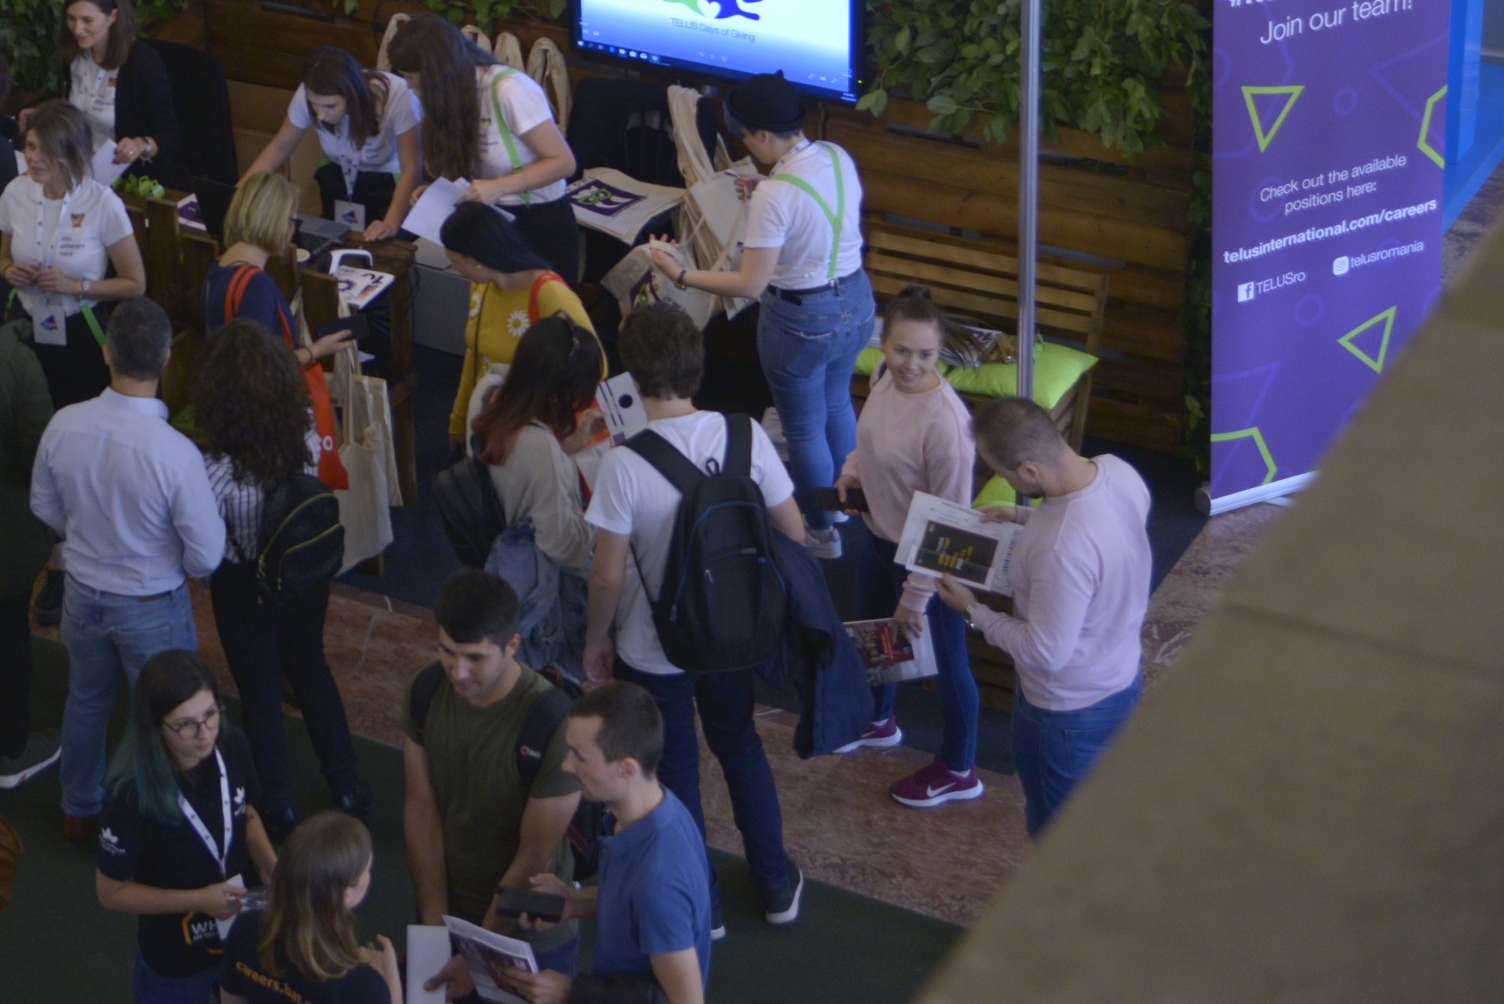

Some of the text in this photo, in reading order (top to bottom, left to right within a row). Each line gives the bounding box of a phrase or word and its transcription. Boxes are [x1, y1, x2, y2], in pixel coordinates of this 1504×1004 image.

[671, 17, 698, 30] TELUS
[699, 23, 719, 35] Days
[1260, 16, 1303, 44] Join
[1309, 7, 1347, 31] our
[1259, 154, 1408, 202] Check out the available
[1284, 181, 1378, 216] positions here:
[1223, 199, 1438, 264] telusinternational.com/careers
[1350, 240, 1424, 268] telusromania
[1256, 271, 1306, 295] TELUSro
[191, 920, 217, 935] WH
